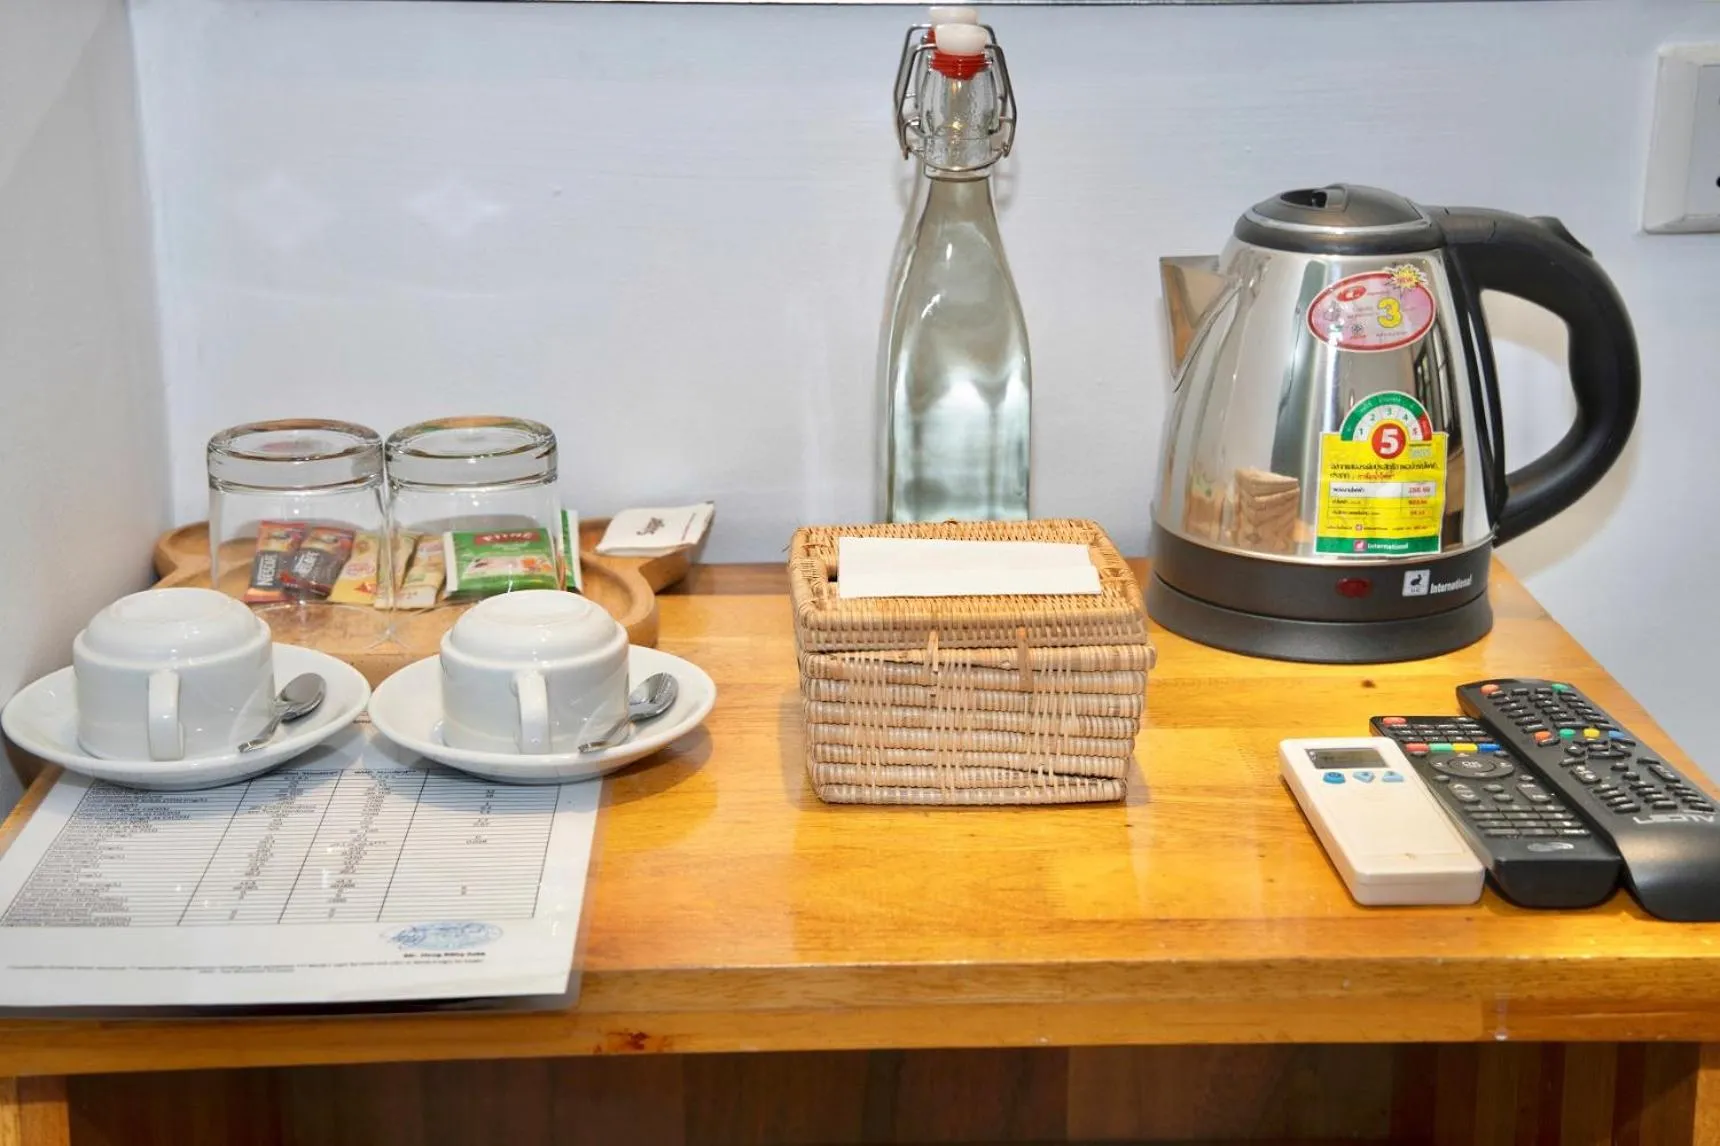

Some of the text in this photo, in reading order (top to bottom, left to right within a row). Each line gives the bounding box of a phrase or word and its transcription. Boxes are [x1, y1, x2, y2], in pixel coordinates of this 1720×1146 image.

[1377, 296, 1403, 329] 3
[1379, 428, 1400, 455] 5
[1367, 541, 1409, 551] International
[1430, 573, 1472, 595] International
